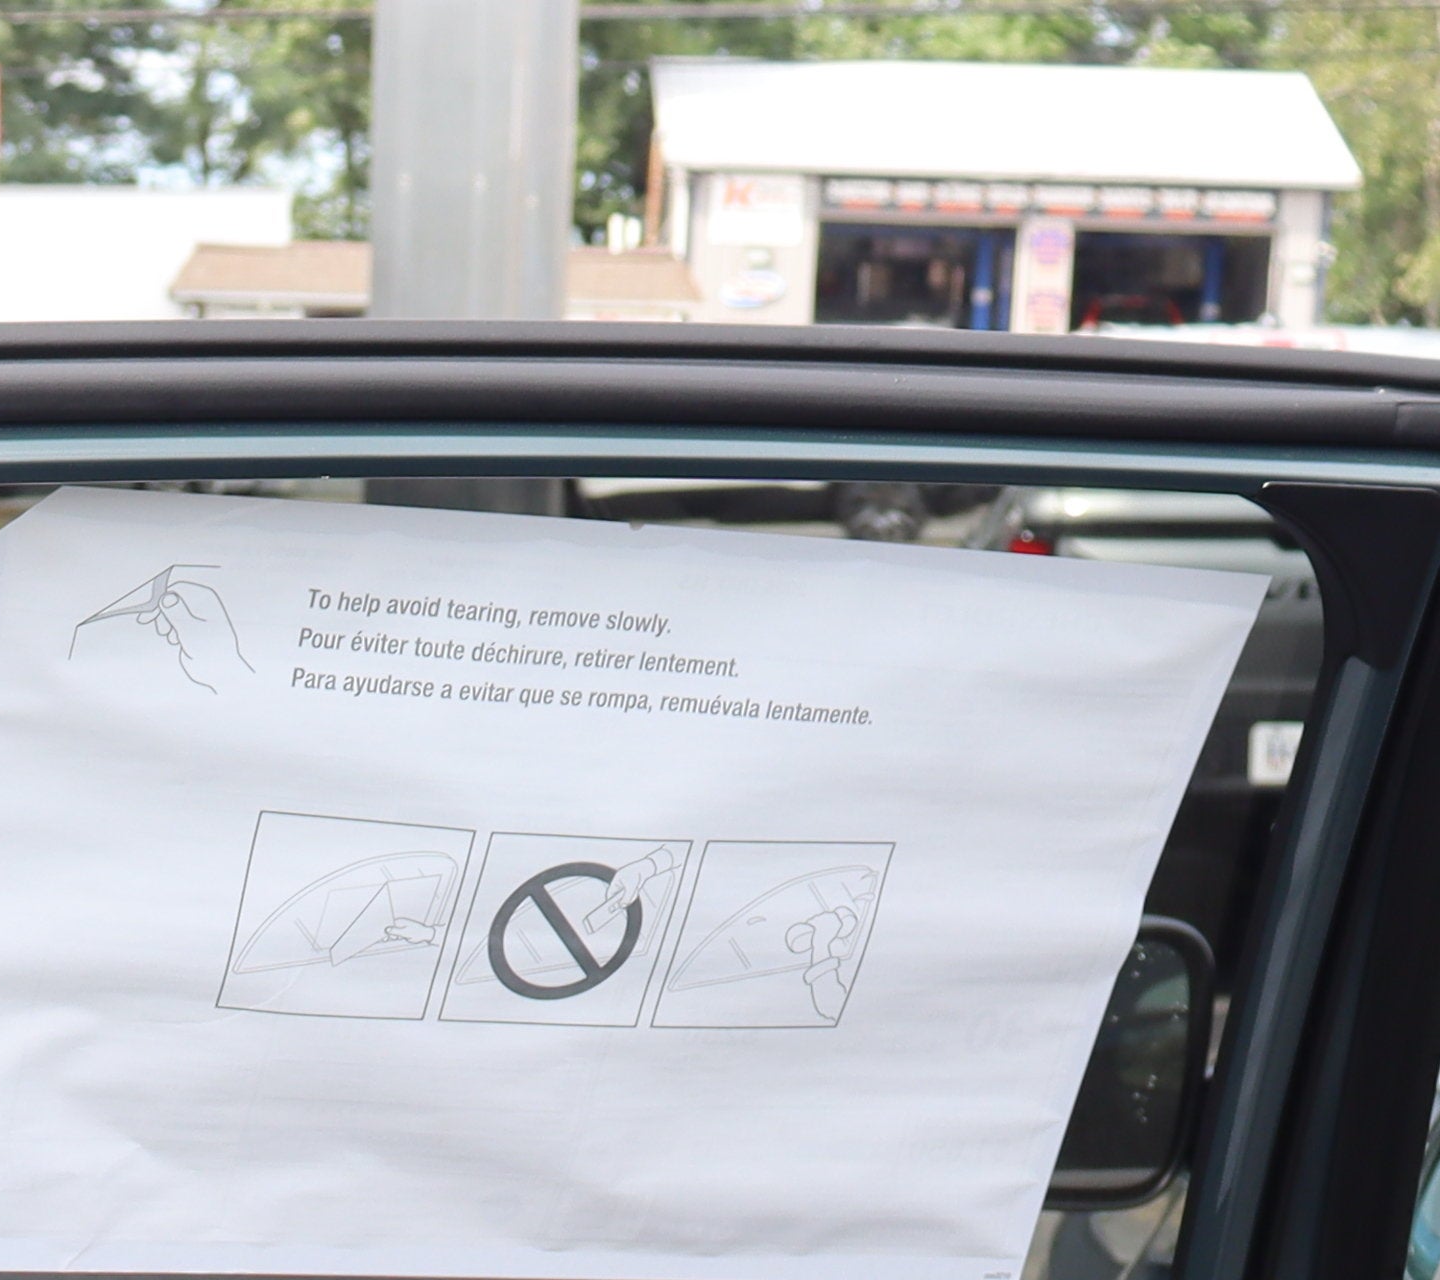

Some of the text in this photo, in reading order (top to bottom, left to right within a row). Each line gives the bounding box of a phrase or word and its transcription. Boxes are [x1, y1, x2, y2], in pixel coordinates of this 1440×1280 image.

[308, 588, 671, 637] To help avoid tearing, remove slowly.
[297, 627, 739, 678] Pour éviter toute déchirure, retirer lentement.
[290, 666, 873, 726] Para ayudarse a evitar que se rompa, remuévala lentamente.
